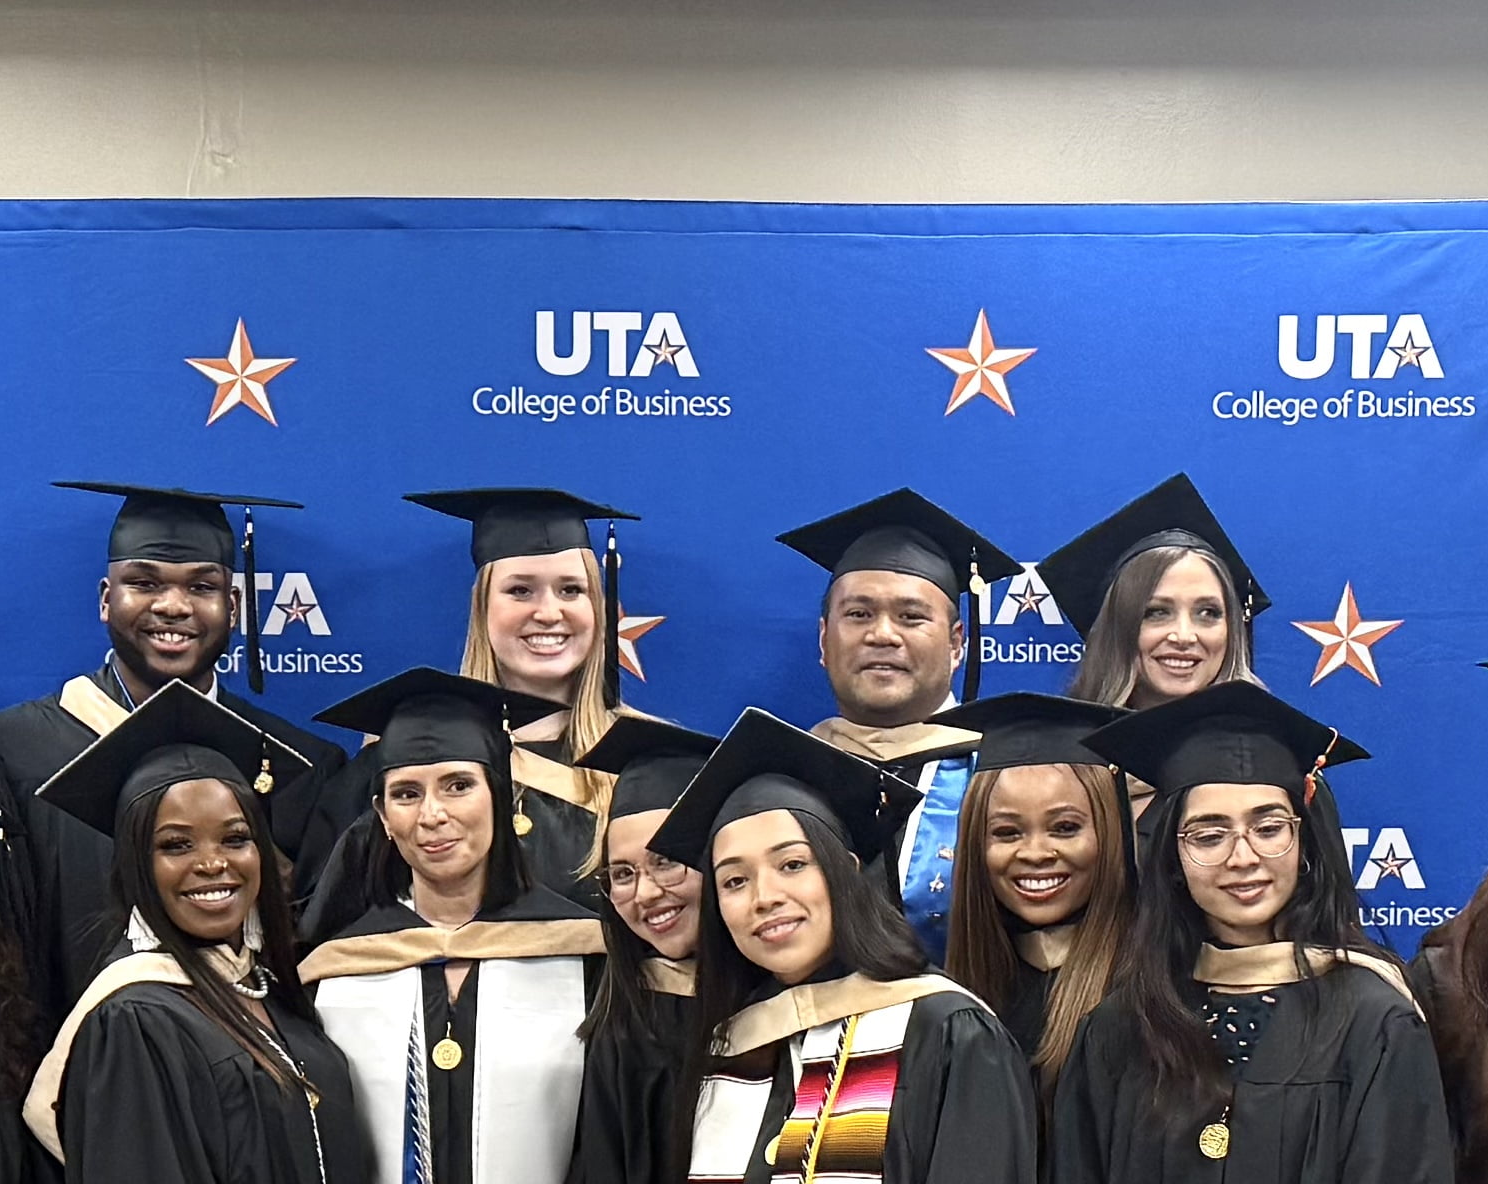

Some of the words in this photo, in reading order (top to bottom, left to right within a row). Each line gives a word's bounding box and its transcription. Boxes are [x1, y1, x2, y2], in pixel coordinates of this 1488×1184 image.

[536, 310, 700, 378] UTA
[1278, 313, 1445, 380] UTA
[472, 386, 576, 422] College
[581, 386, 612, 416] of
[614, 388, 731, 417] Business
[1212, 390, 1318, 426] College
[1322, 389, 1353, 418] of
[1357, 391, 1476, 419] Business
[231, 572, 333, 635] TA
[214, 645, 244, 673] of
[980, 636, 1087, 663] Busines
